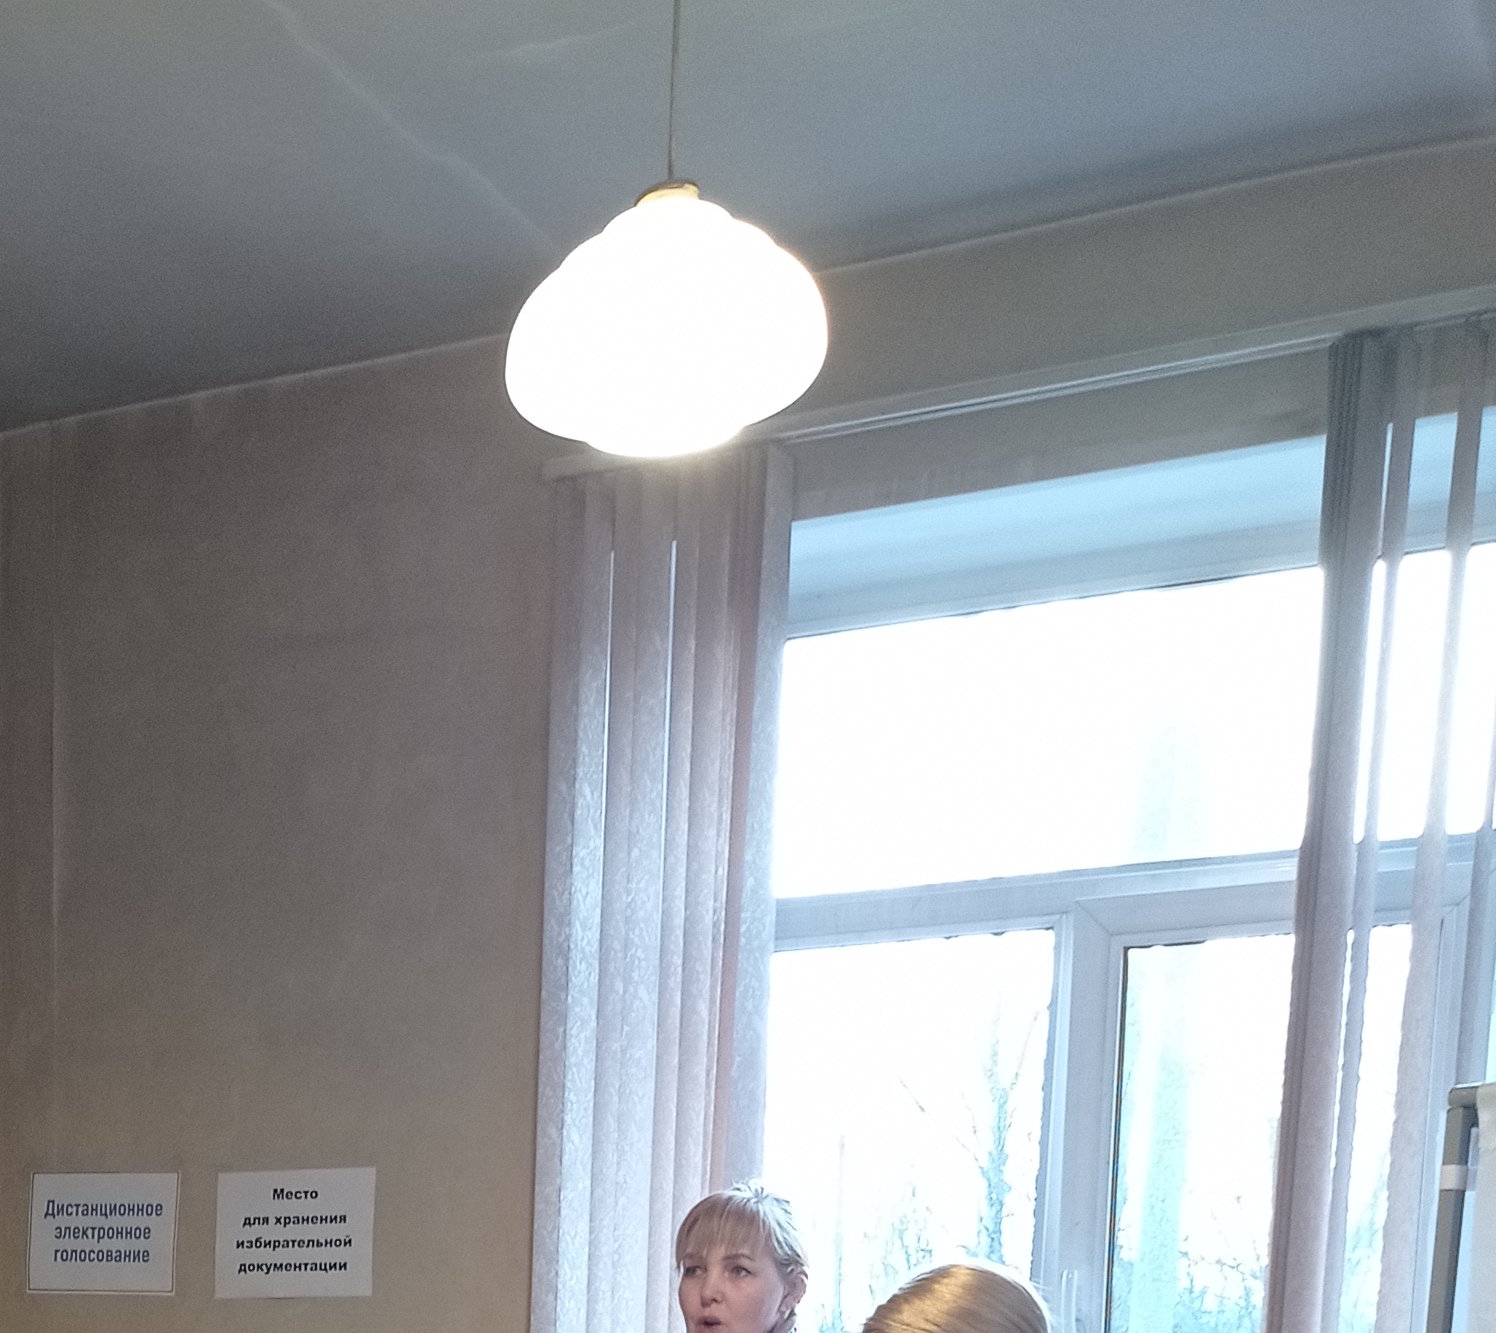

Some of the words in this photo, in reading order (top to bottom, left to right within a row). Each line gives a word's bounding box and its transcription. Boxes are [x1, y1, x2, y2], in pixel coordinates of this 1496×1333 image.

[272, 1188, 319, 1201] Место
[44, 1199, 163, 1219] Дистанционное
[242, 1216, 270, 1229] для
[274, 1214, 347, 1228] хранения
[54, 1225, 151, 1243] электронное
[236, 1235, 353, 1251] избирательной
[53, 1249, 150, 1263] голосование
[238, 1261, 348, 1275] документации
